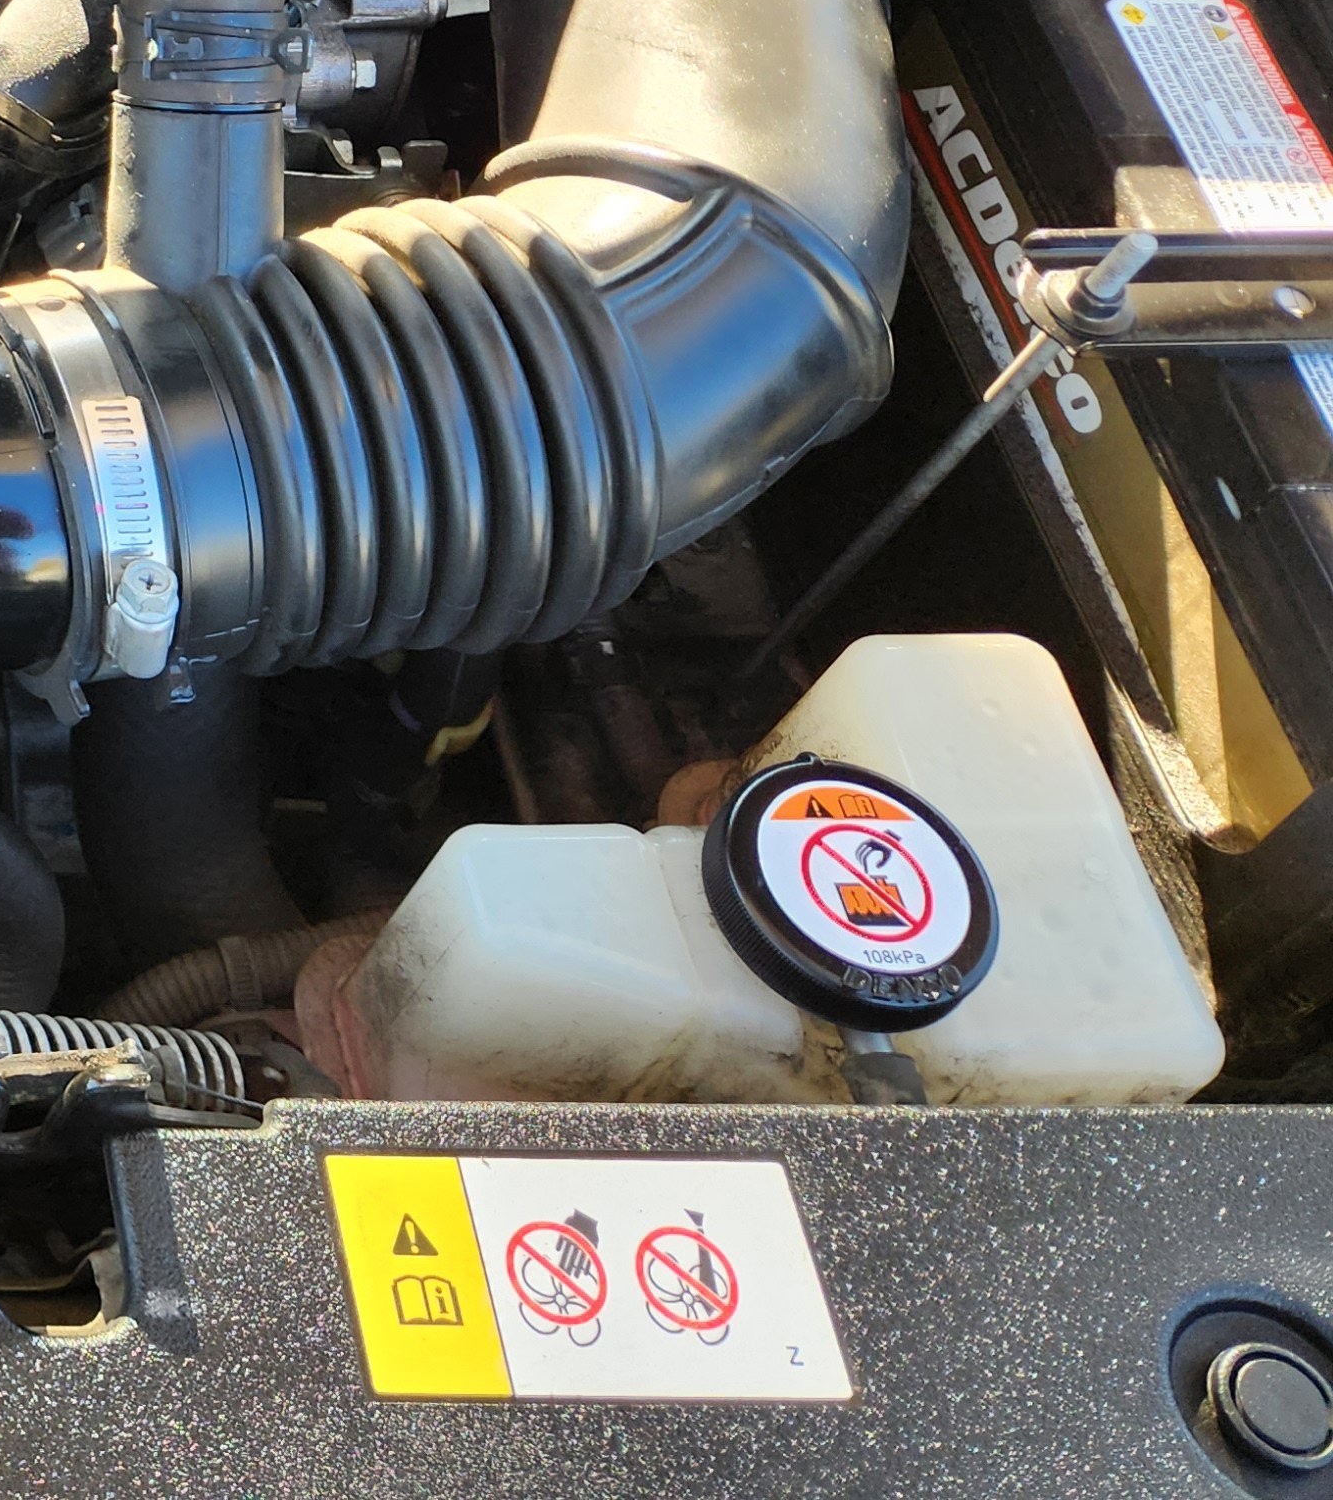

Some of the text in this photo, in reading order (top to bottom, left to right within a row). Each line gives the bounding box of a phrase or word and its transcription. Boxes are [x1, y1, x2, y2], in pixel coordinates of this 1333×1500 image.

[912, 85, 1104, 434] ACDeo
[863, 949, 926, 964] 108kPa
[841, 964, 963, 1002] DENSO
